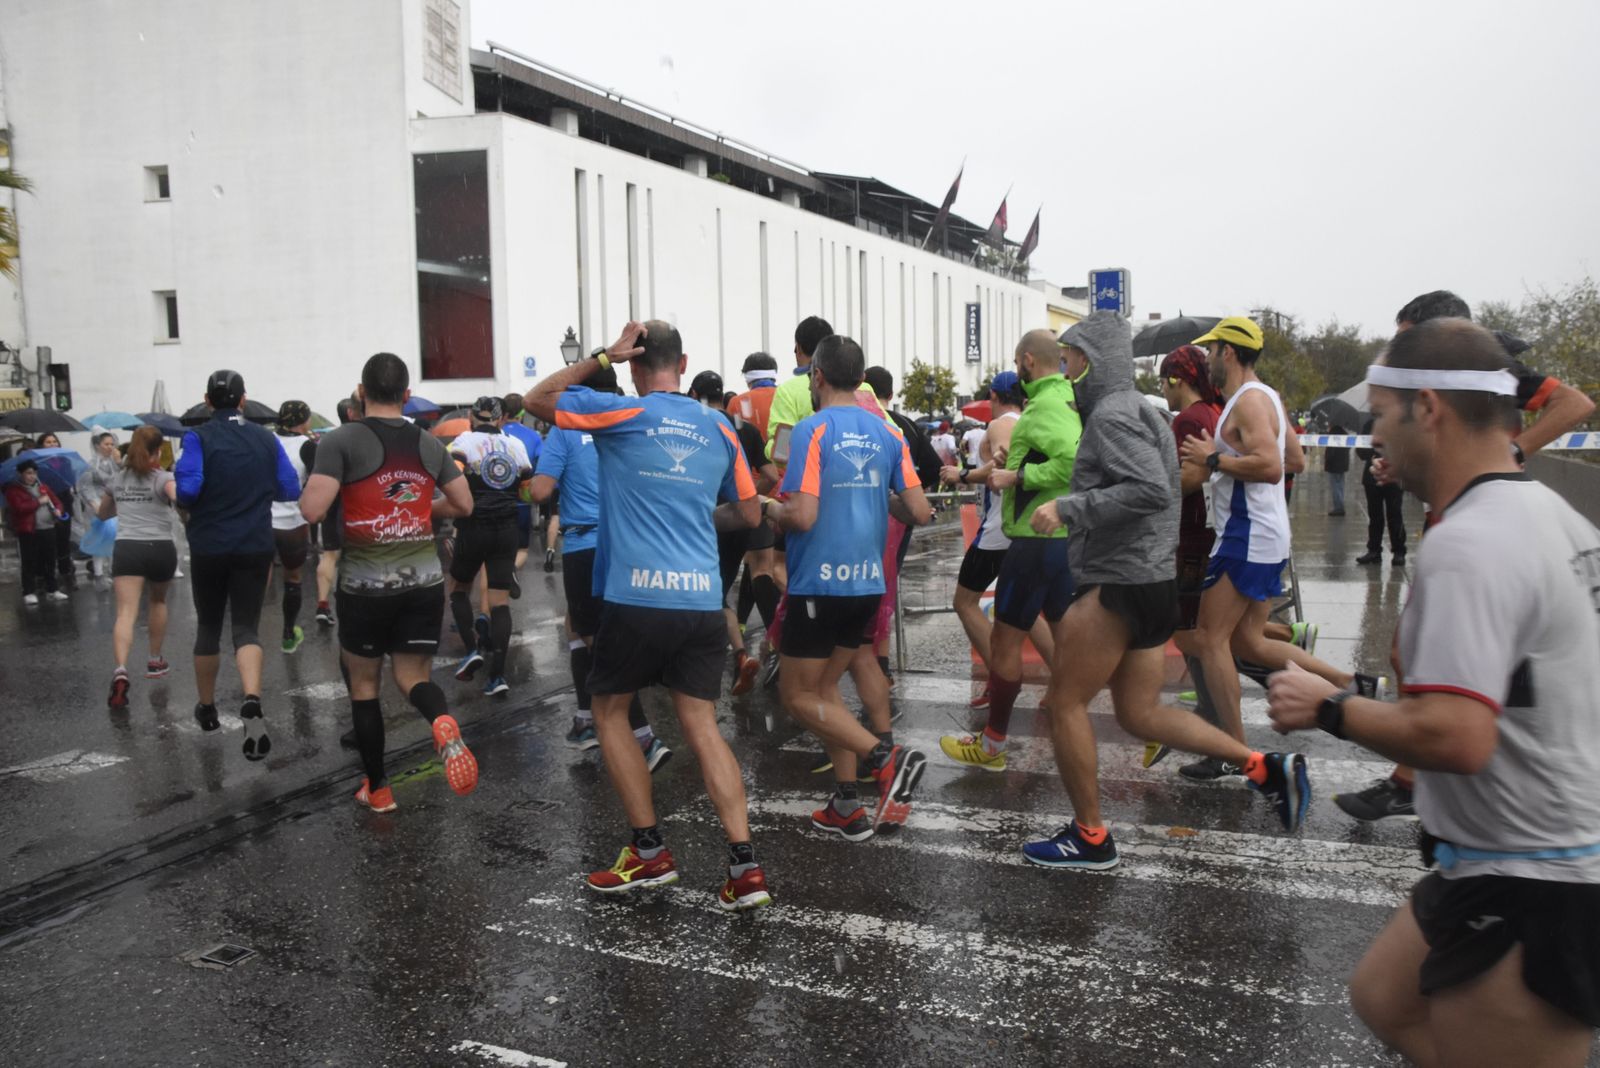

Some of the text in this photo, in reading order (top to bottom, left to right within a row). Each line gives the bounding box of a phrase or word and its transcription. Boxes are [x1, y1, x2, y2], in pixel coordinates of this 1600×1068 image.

[968, 345, 979, 355] 24
[377, 469, 428, 485] LOS KENYATAS
[631, 567, 711, 592] MARTÍN
[819, 559, 881, 582] SOFÍA
